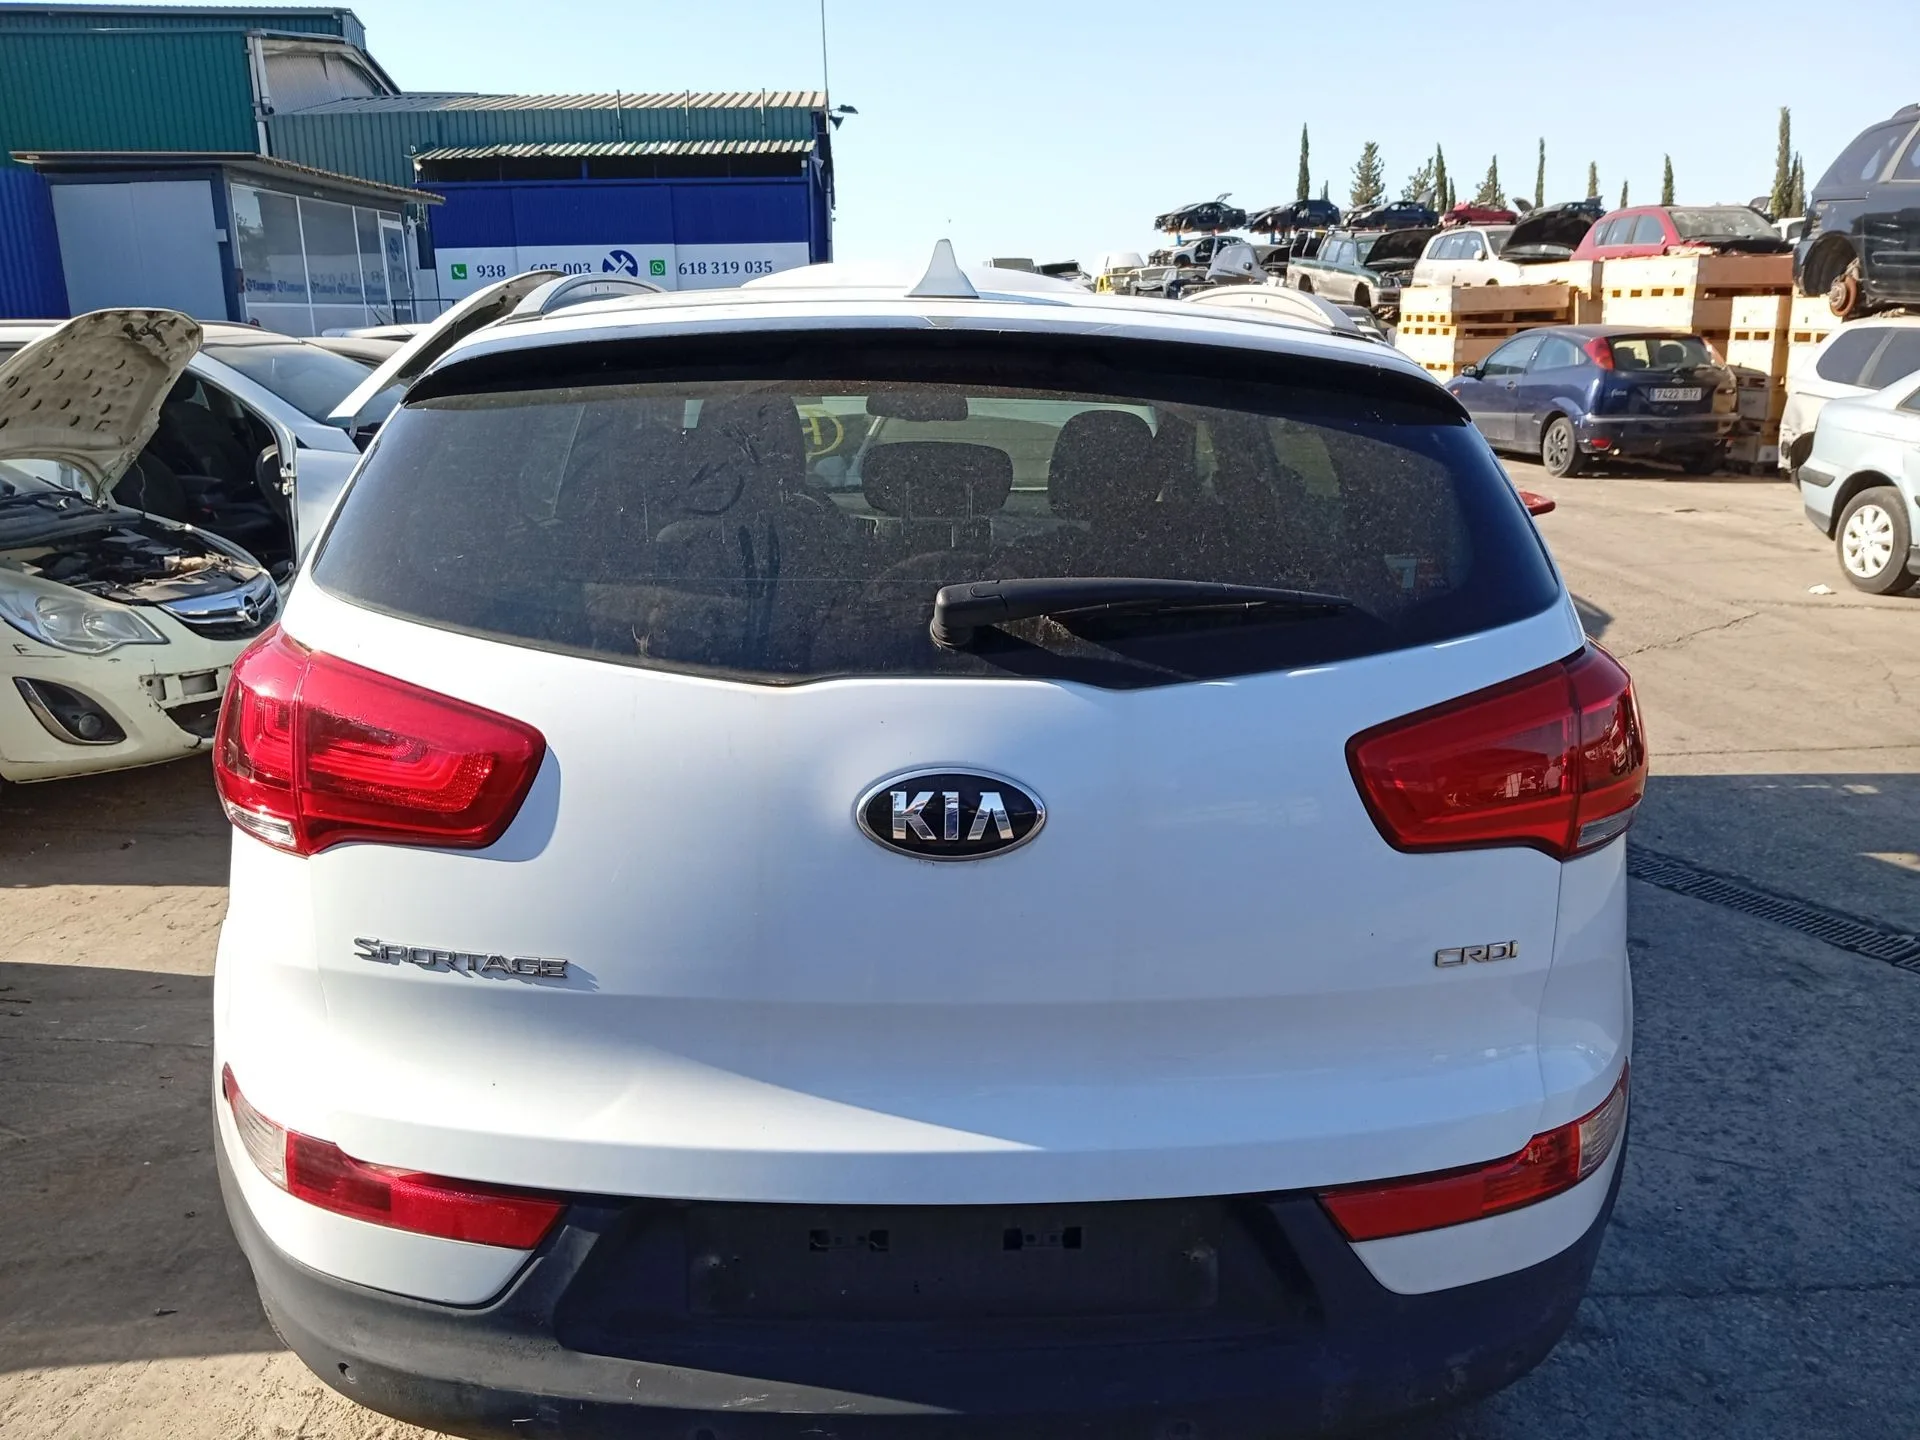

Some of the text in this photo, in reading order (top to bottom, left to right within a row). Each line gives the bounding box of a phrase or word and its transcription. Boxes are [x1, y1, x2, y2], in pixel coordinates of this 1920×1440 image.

[476, 264, 506, 278] 938
[678, 260, 773, 275] 618 319 035
[890, 791, 1015, 841] KIA
[353, 936, 569, 979] SPORTAGE
